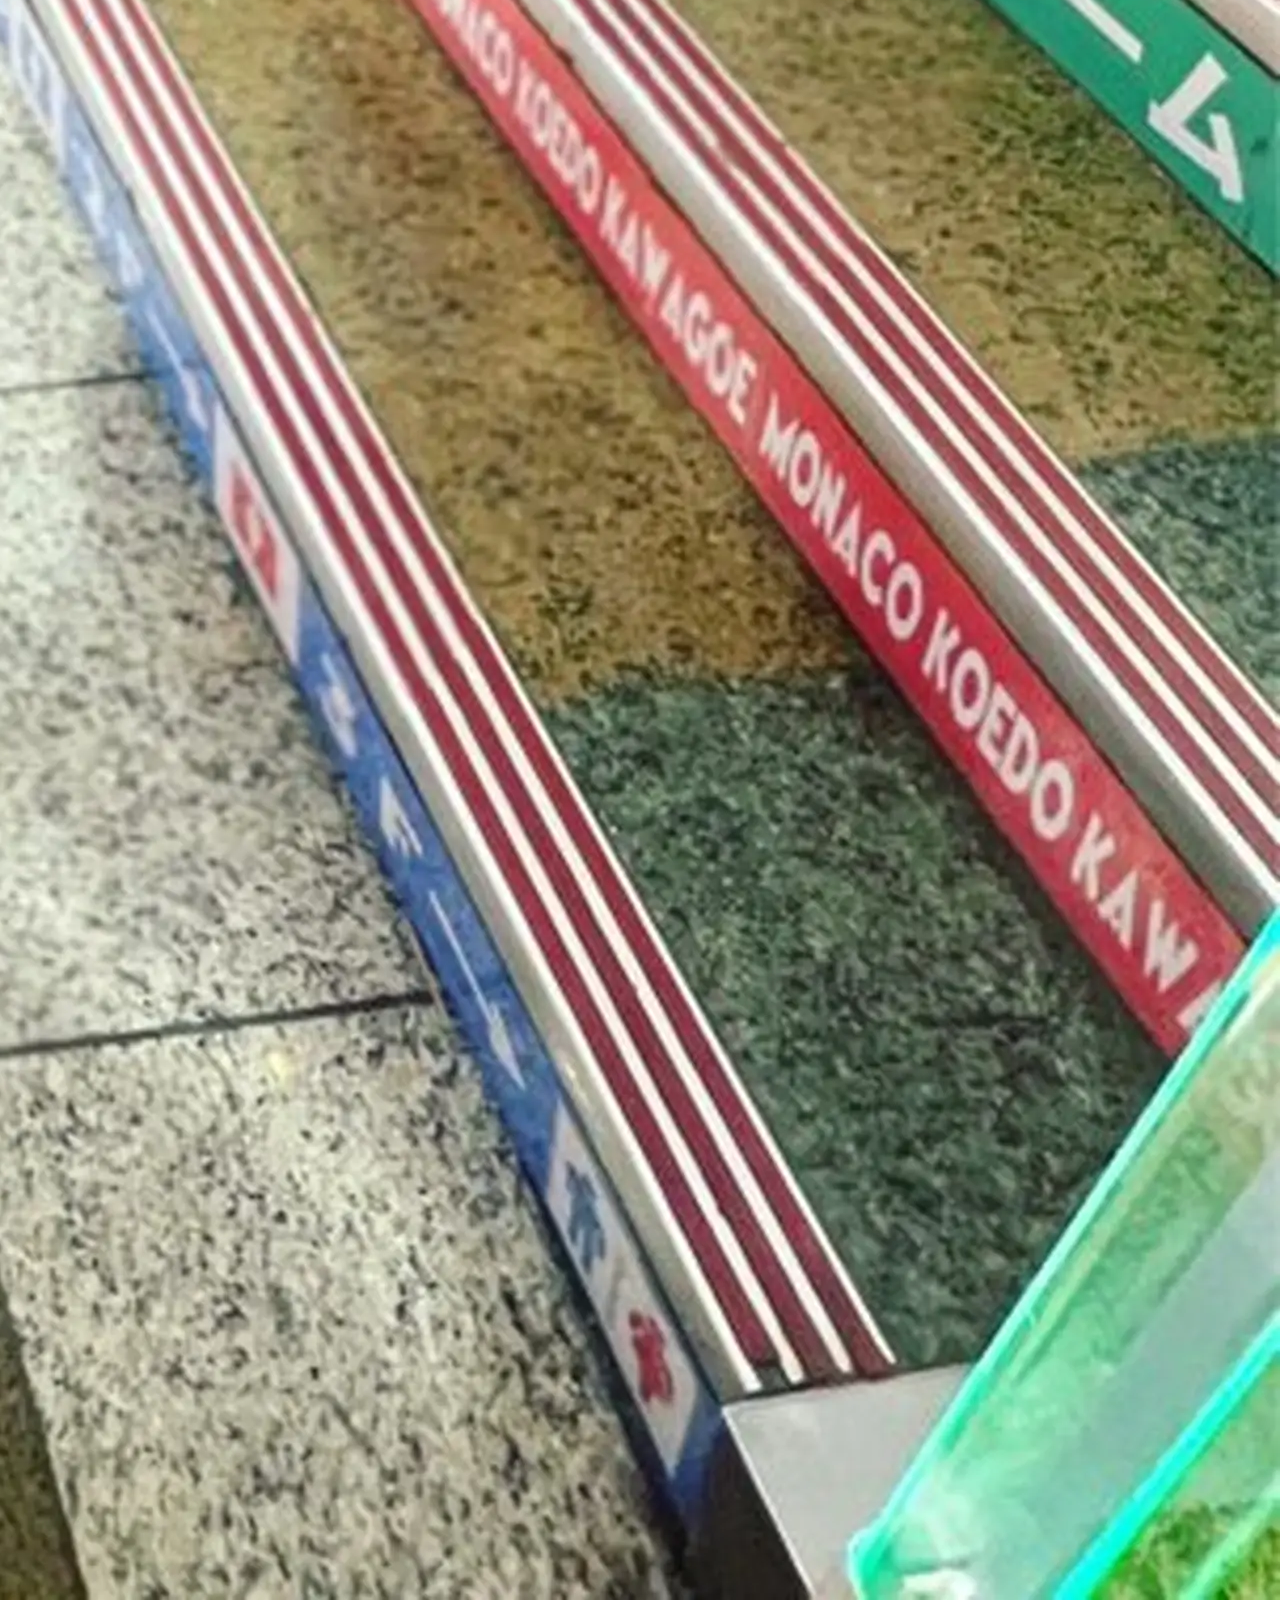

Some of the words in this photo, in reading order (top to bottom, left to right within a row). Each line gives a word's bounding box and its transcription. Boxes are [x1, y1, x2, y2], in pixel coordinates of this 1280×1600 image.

[512, 65, 601, 218] KOEDO
[597, 174, 758, 426] KAWAGOE
[758, 395, 926, 644] MONACO
[920, 607, 1078, 842] KOEDO
